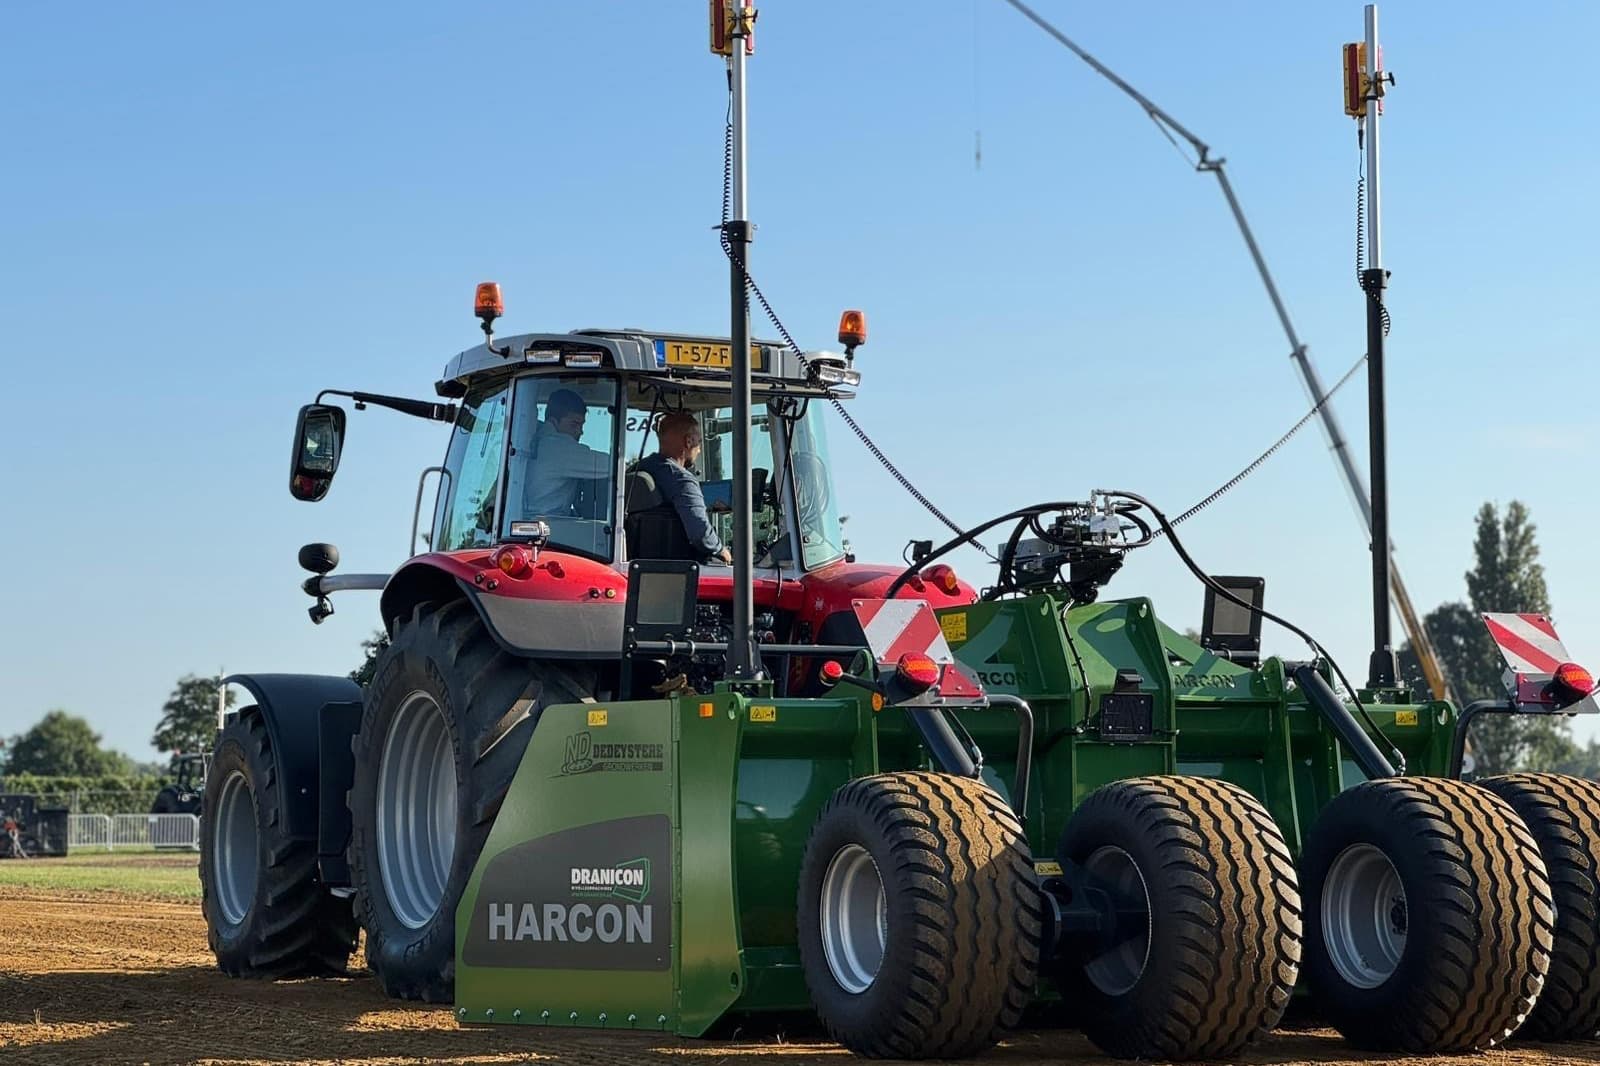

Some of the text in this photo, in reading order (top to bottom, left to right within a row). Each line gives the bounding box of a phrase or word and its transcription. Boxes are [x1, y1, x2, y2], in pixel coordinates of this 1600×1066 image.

[672, 344, 729, 364] T-57-F
[977, 671, 1030, 686] RCON
[1174, 673, 1236, 689] ARCON
[571, 868, 644, 886] DRANICON
[488, 903, 653, 944] HARCON
